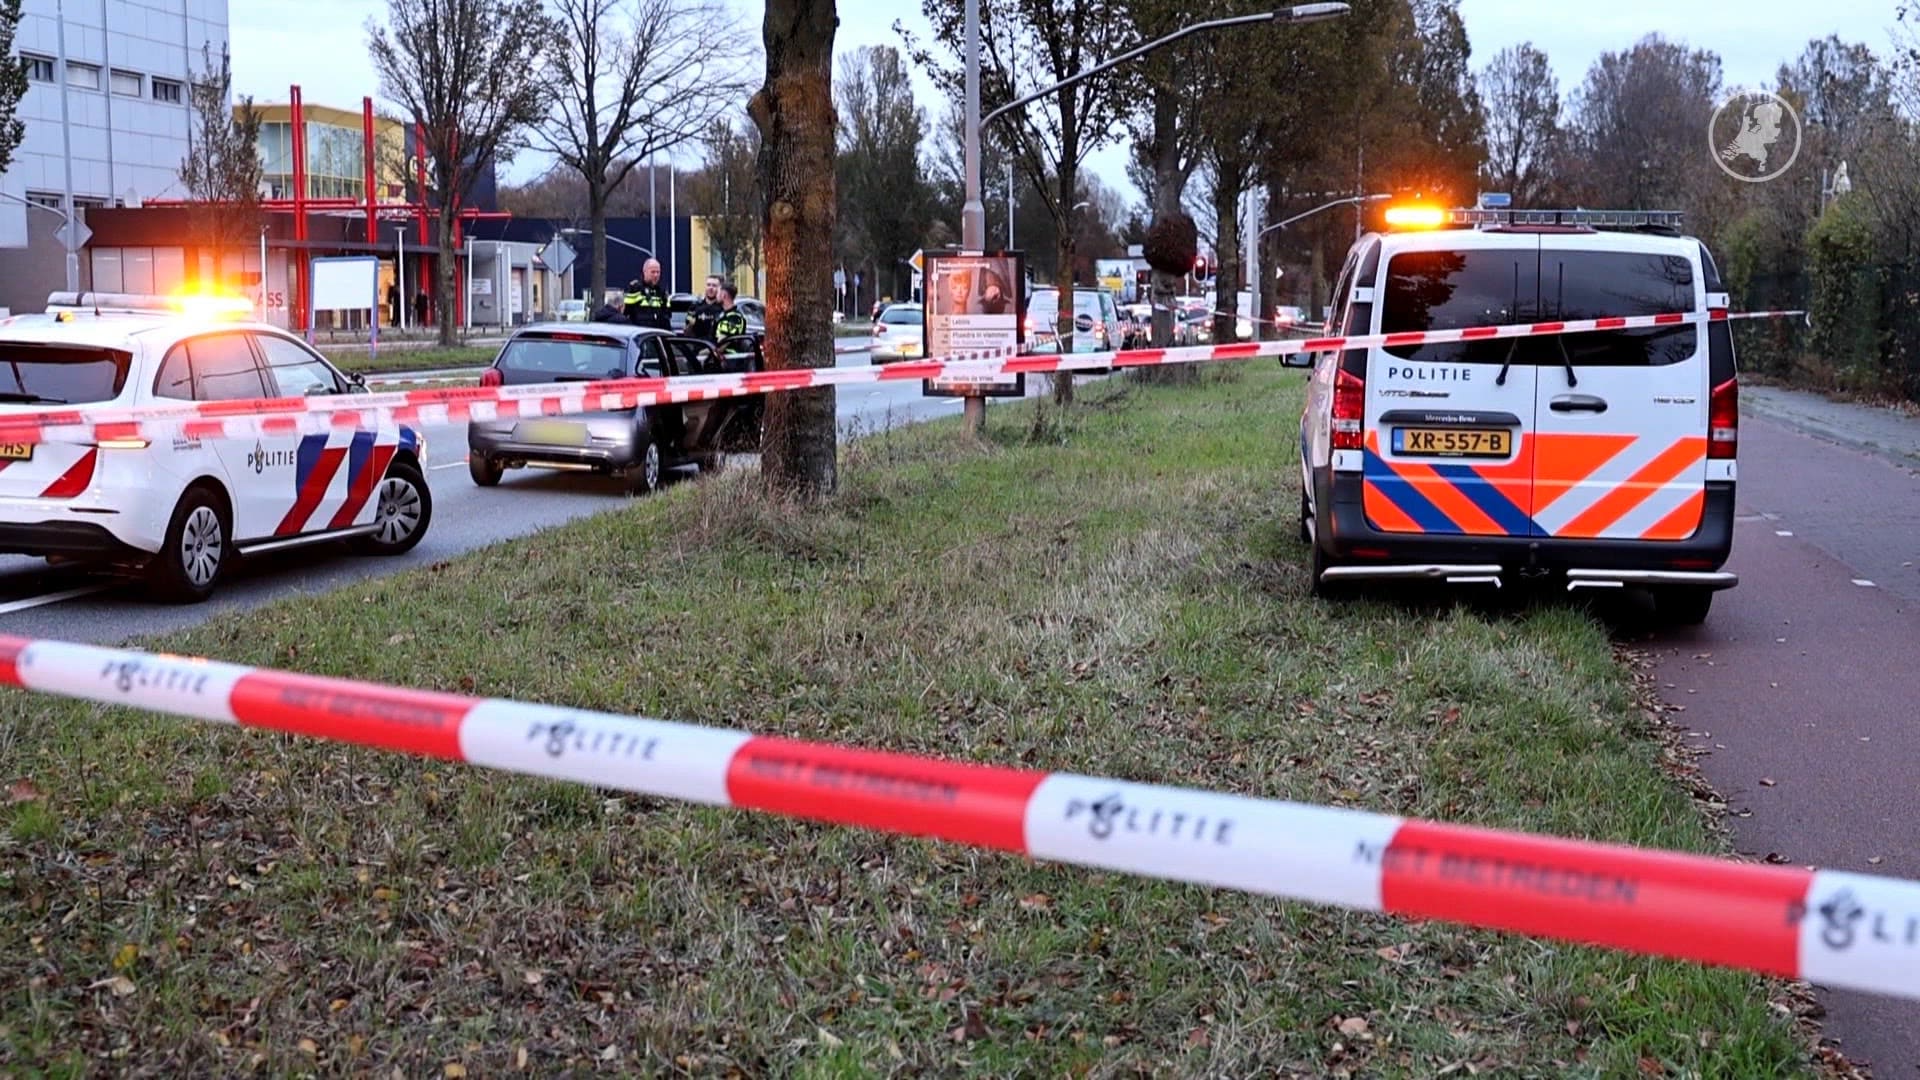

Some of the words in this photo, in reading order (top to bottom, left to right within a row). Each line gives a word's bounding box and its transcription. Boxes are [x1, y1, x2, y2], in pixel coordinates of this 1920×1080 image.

[1389, 367, 1471, 381] POLITIE
[1410, 432, 1502, 451] XR-557-B
[526, 716, 661, 762] POLITIE
[1065, 793, 1233, 845] POLITIE
[1354, 840, 1429, 874] NIET
[1438, 853, 1640, 905] BETREDEN
